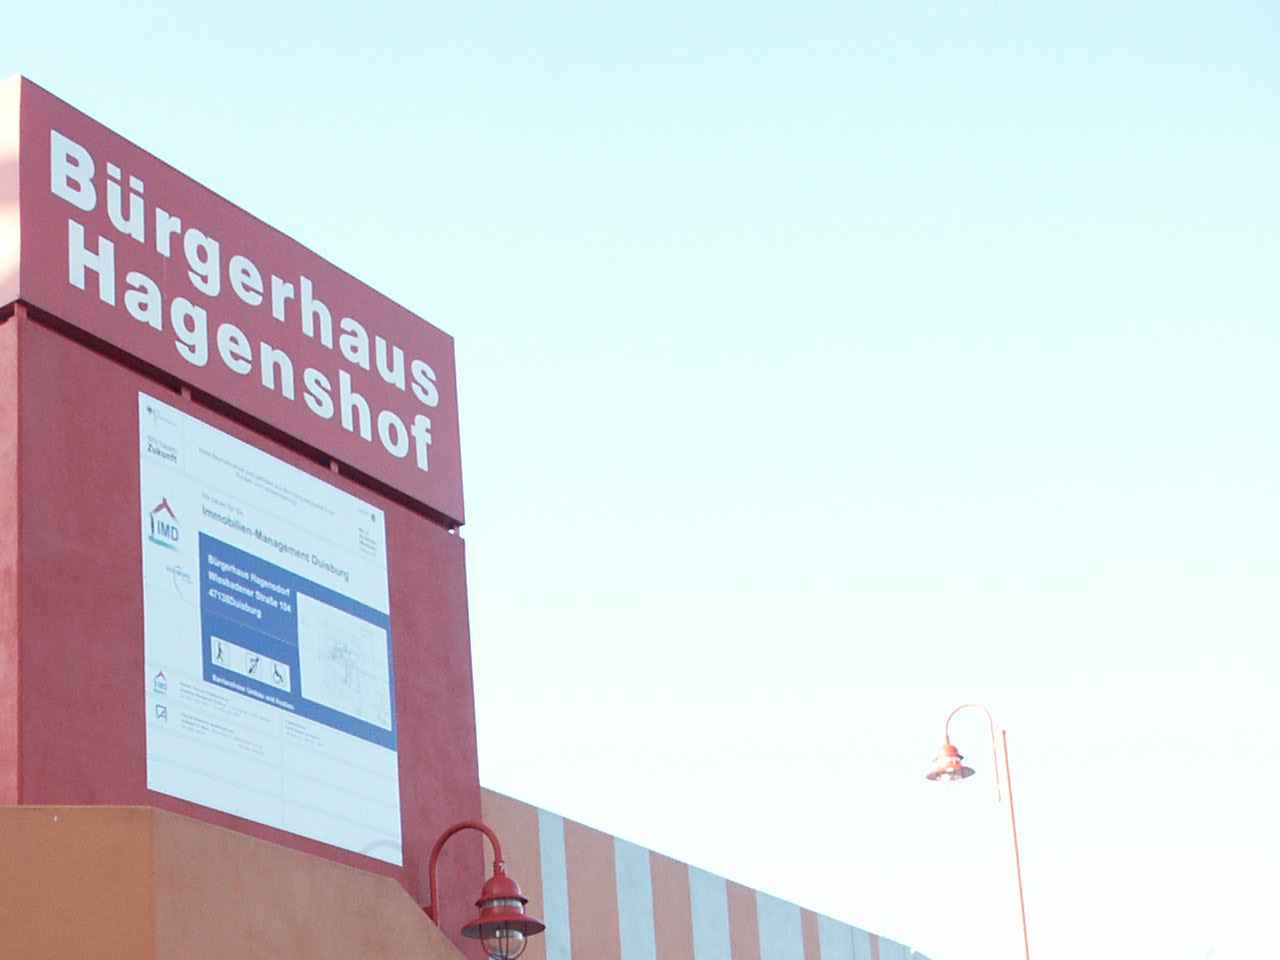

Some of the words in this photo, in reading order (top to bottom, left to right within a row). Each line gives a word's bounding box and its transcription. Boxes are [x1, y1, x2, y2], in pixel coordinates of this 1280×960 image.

[50, 128, 439, 408] Bürgerhaus
[68, 217, 431, 472] Hagenshof
[157, 519, 179, 542] IMD
[202, 504, 310, 564] Immobilien-Management
[311, 552, 350, 583] Duisburg
